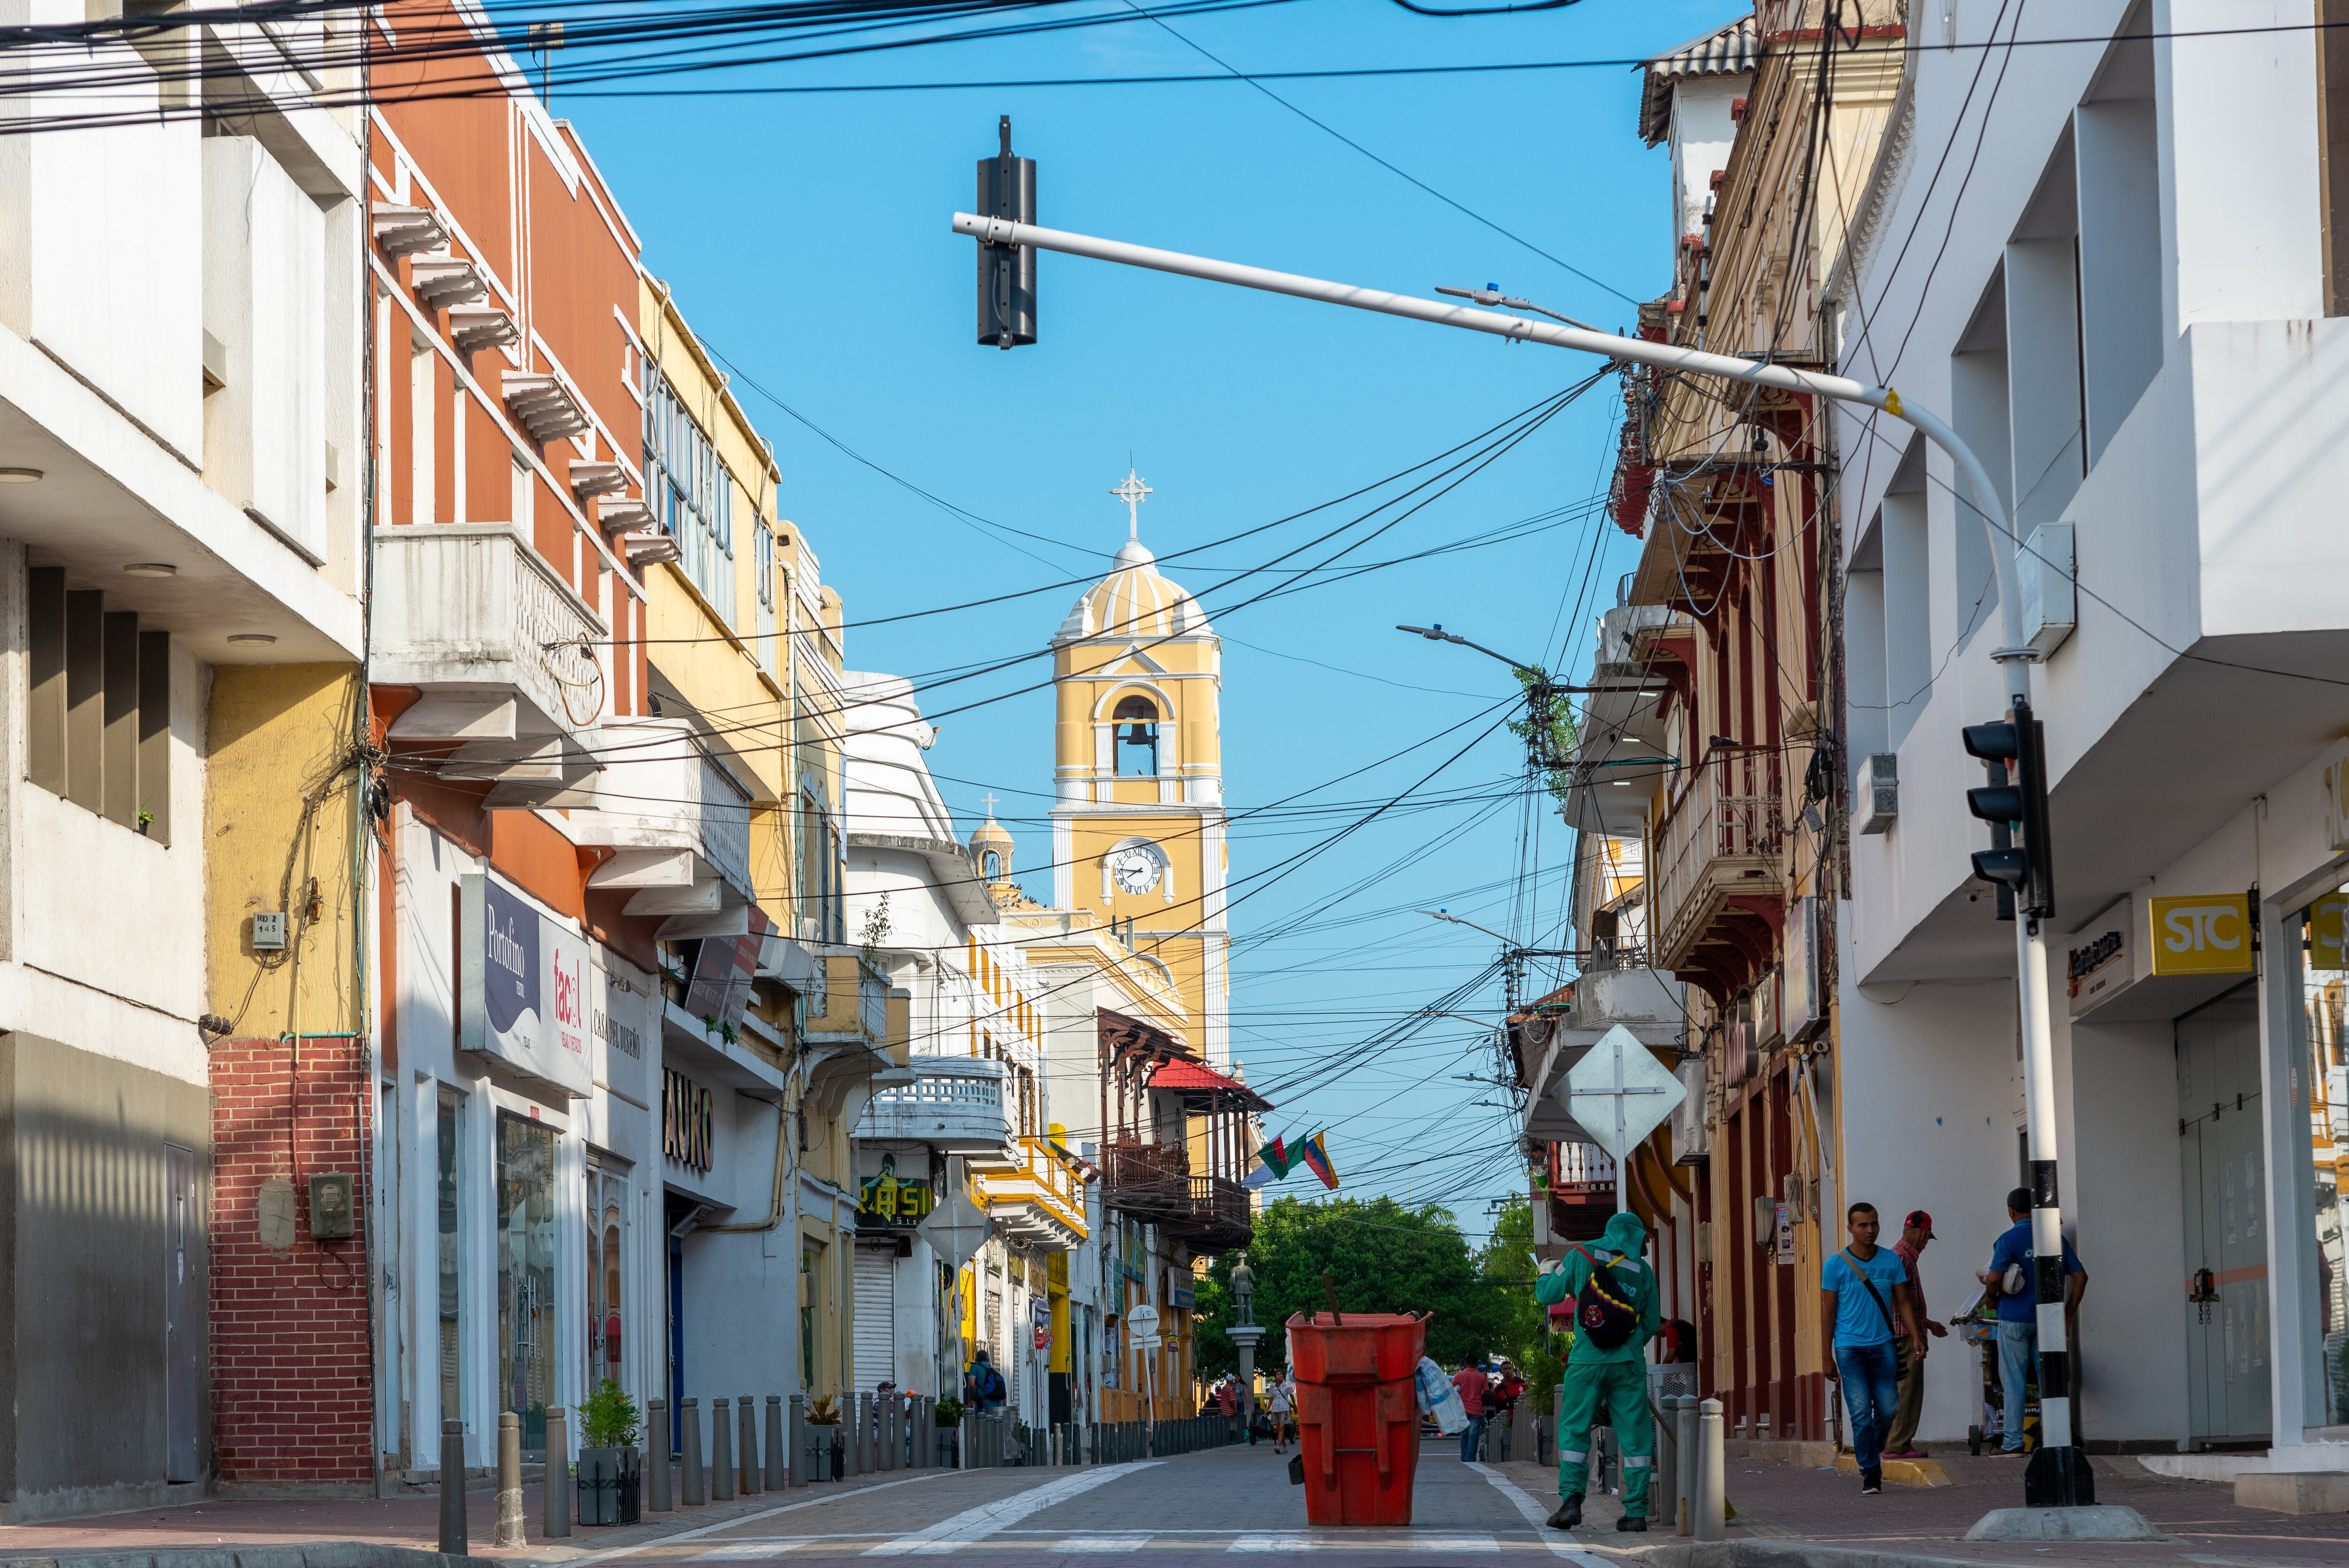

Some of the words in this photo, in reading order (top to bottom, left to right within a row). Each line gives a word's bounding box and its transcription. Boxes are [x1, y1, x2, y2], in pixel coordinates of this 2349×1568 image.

[488, 903, 524, 978] Portofino
[2165, 906, 2240, 952] STC
[554, 948, 581, 1029] facol
[594, 1008, 608, 1042] CASA
[609, 1017, 619, 1048] DEL
[620, 1025, 640, 1060] DISEÑO
[662, 1066, 714, 1173] AURO
